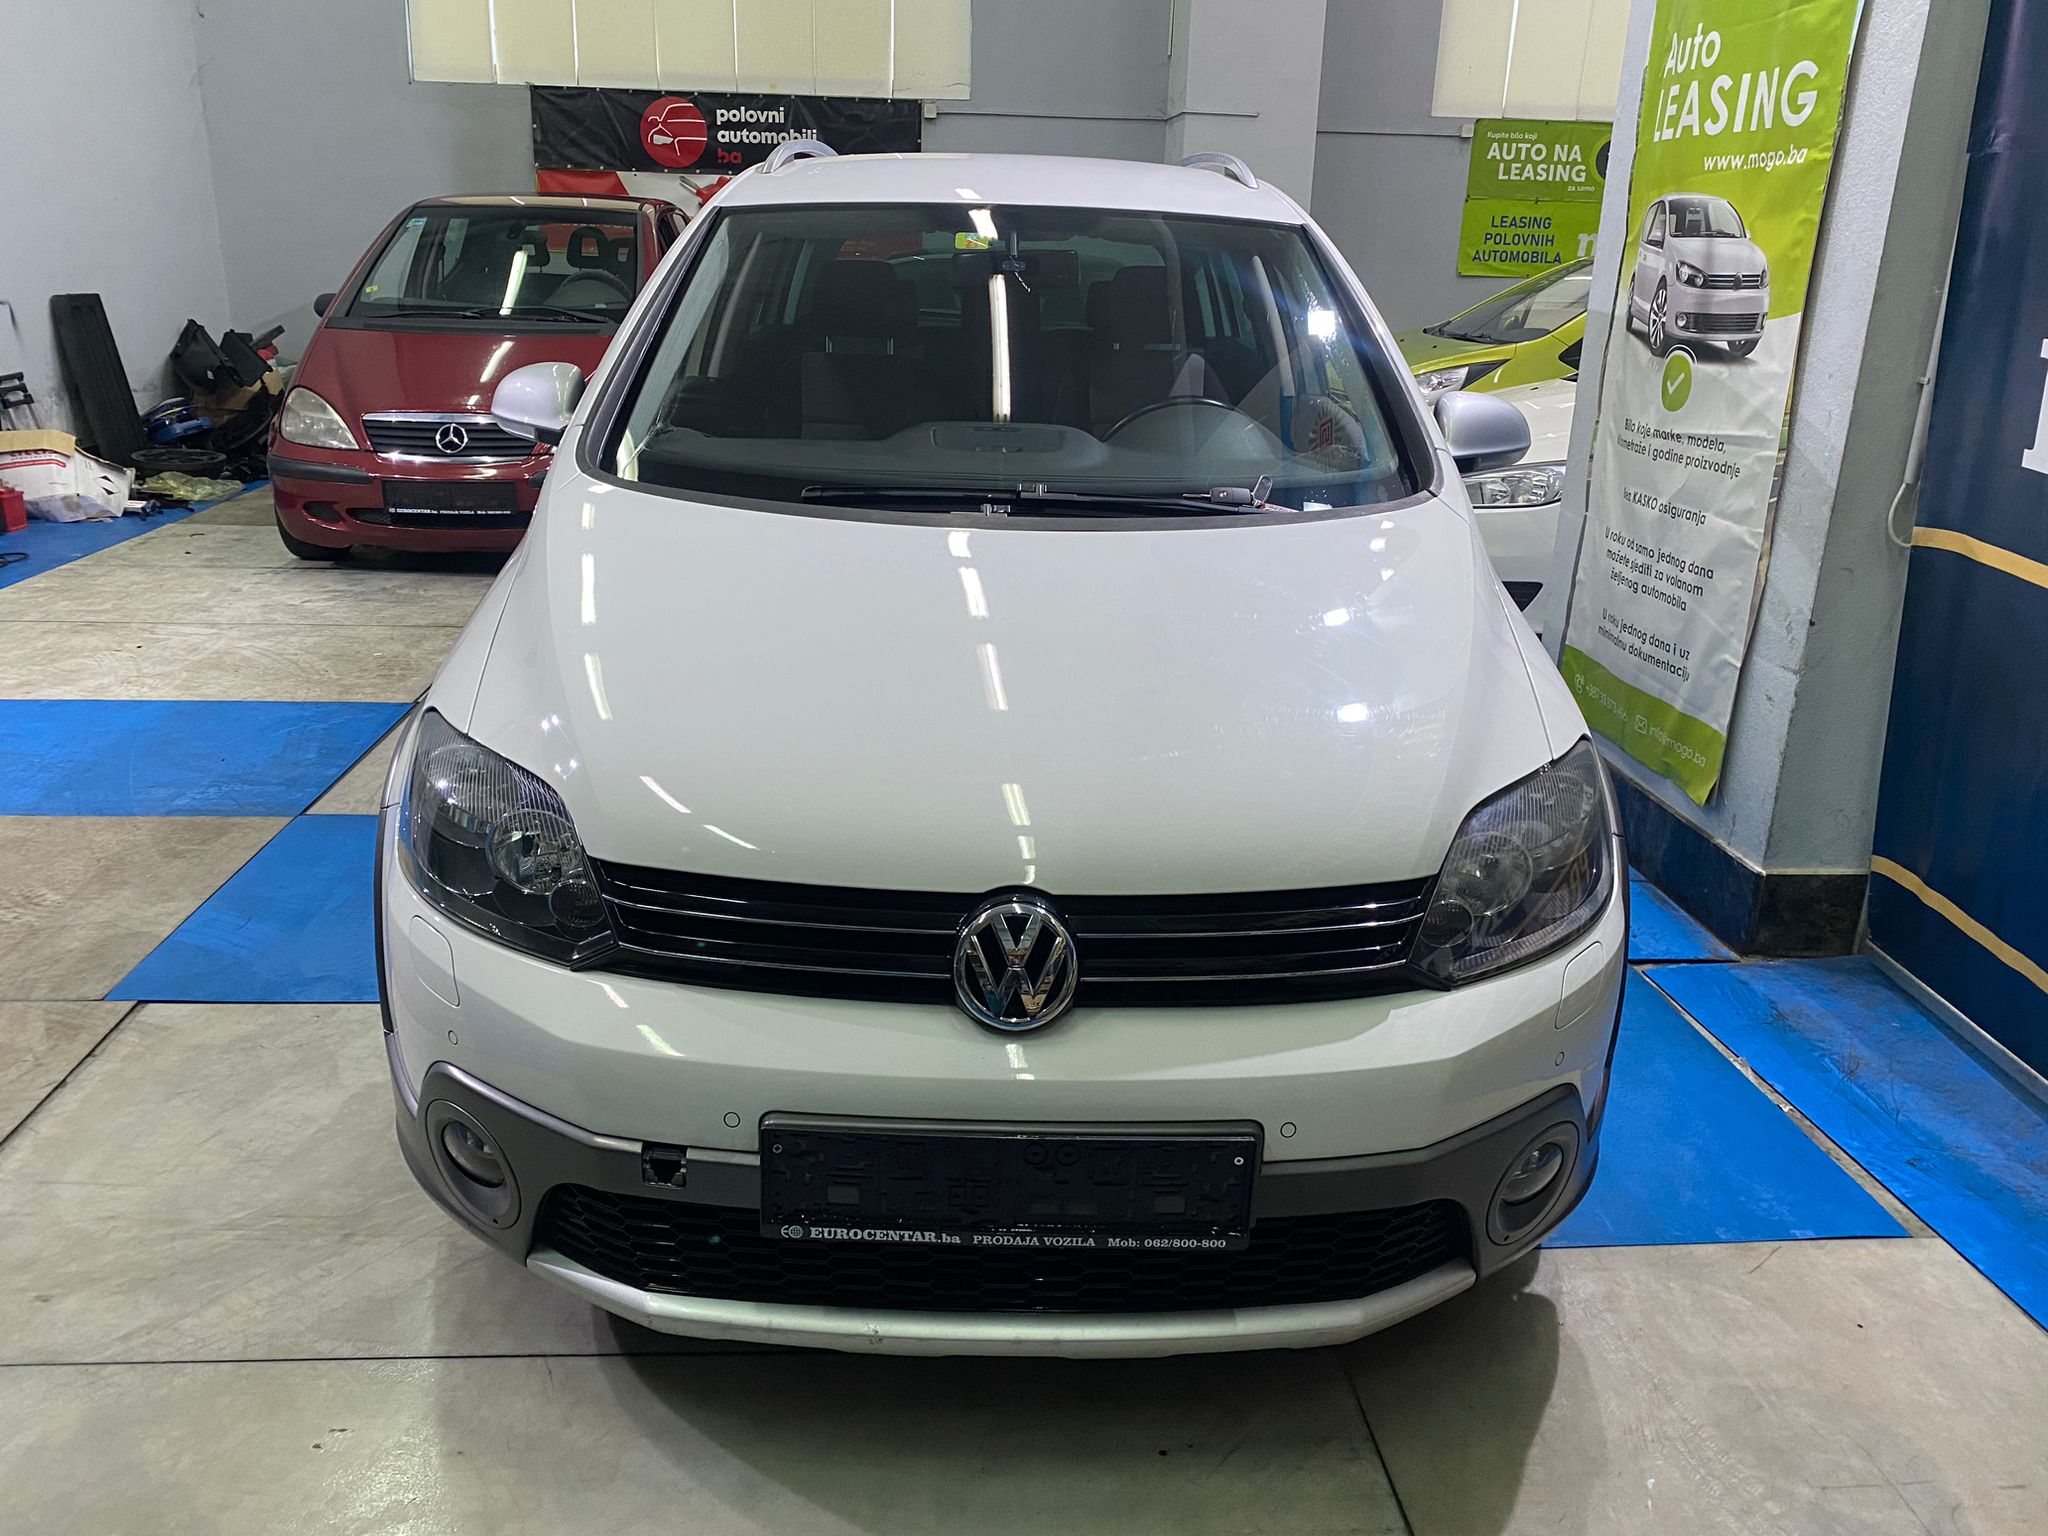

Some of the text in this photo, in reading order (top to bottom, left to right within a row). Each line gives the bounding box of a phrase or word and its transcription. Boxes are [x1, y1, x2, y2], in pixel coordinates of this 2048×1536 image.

[1664, 23, 1721, 78] Auto
[716, 106, 784, 125] polovni
[1653, 60, 1819, 142] LEASING
[717, 128, 817, 144] automobili
[1487, 131, 1537, 140] Kupite bilo koji
[1486, 142, 1582, 162] AUTO NA
[1704, 144, 1808, 172] www.mogo.ba
[1498, 163, 1586, 182] LEASING
[1491, 216, 1552, 229] LEASING
[1484, 233, 1555, 246] POLOVNIH
[1472, 250, 1562, 264] AUTOMOBILA
[1624, 418, 1726, 454] Bilo koje marke, modela,
[1648, 446, 1651, 456] i
[1652, 449, 1684, 464] godine
[1684, 455, 1741, 479] proizvodnje
[1632, 491, 1658, 510] KASKO
[1658, 503, 1706, 526] osiguranja
[1605, 527, 1714, 579] U roku od samo jednog dana
[1606, 548, 1704, 597] možete sjediti za volanom
[1610, 567, 1687, 611] željenog automobila
[1602, 608, 1608, 620] U
[1619, 619, 1647, 644] jednog
[1649, 633, 1671, 653] dana
[1673, 643, 1676, 656] i
[1679, 648, 1690, 660] uz
[1598, 625, 1690, 682] minimalnu dokumentaciju
[810, 1227, 1226, 1248] EUROCENTAR.ba PRODAJA VOZILA Mob: 062/800-800
